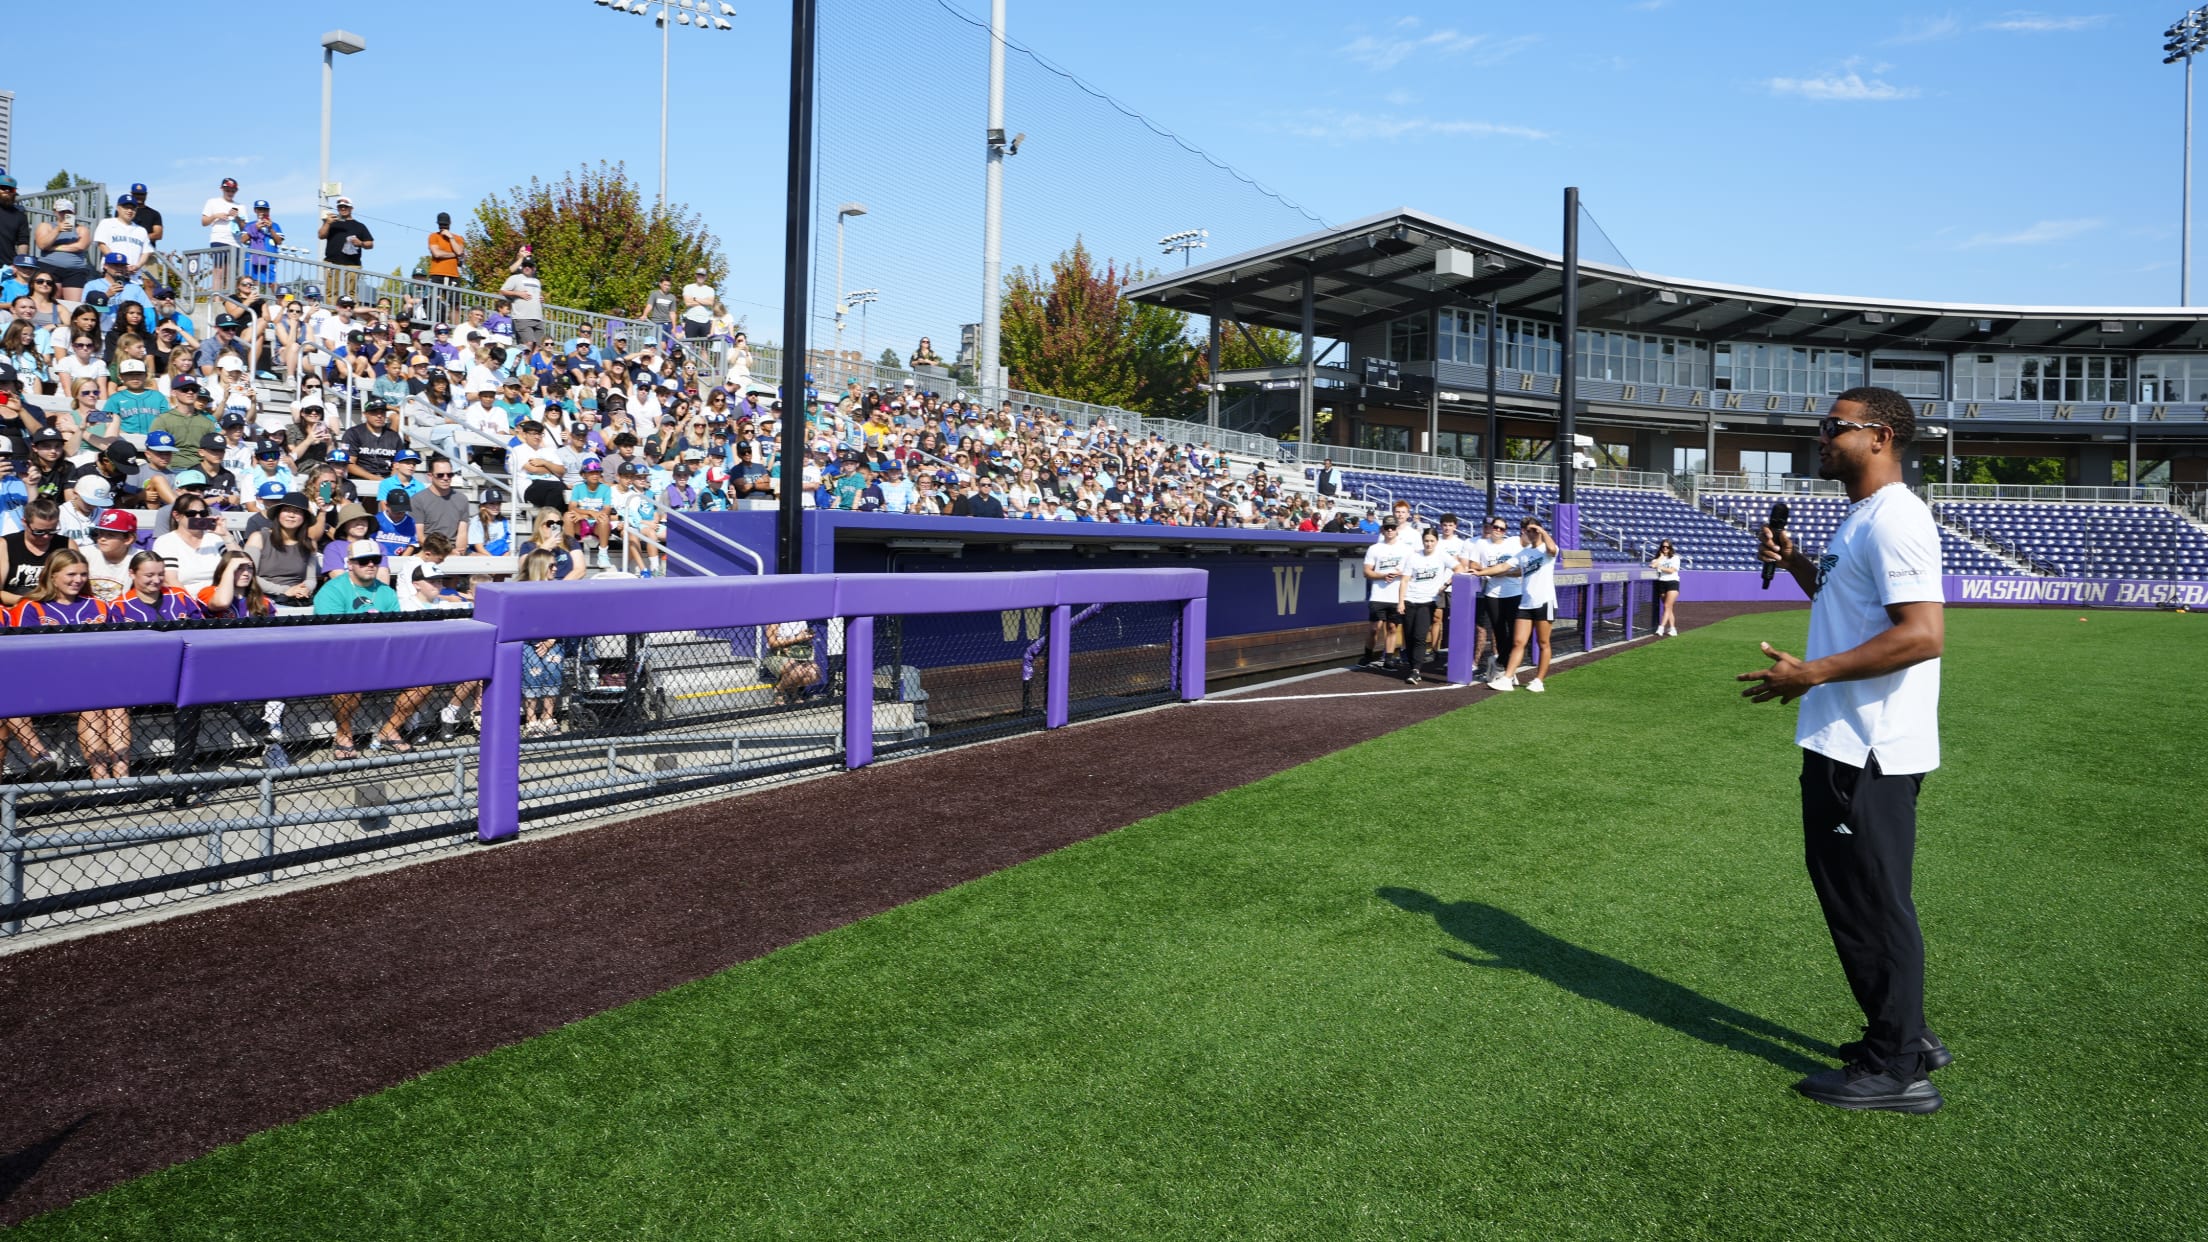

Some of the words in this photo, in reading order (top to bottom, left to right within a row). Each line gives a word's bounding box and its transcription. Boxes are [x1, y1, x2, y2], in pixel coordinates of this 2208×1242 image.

[1622, 385, 1818, 412] DIAMON
[1921, 402, 1981, 418] ON
[1272, 566, 1304, 616] W
[1962, 579, 2109, 602] WASHINGTON
